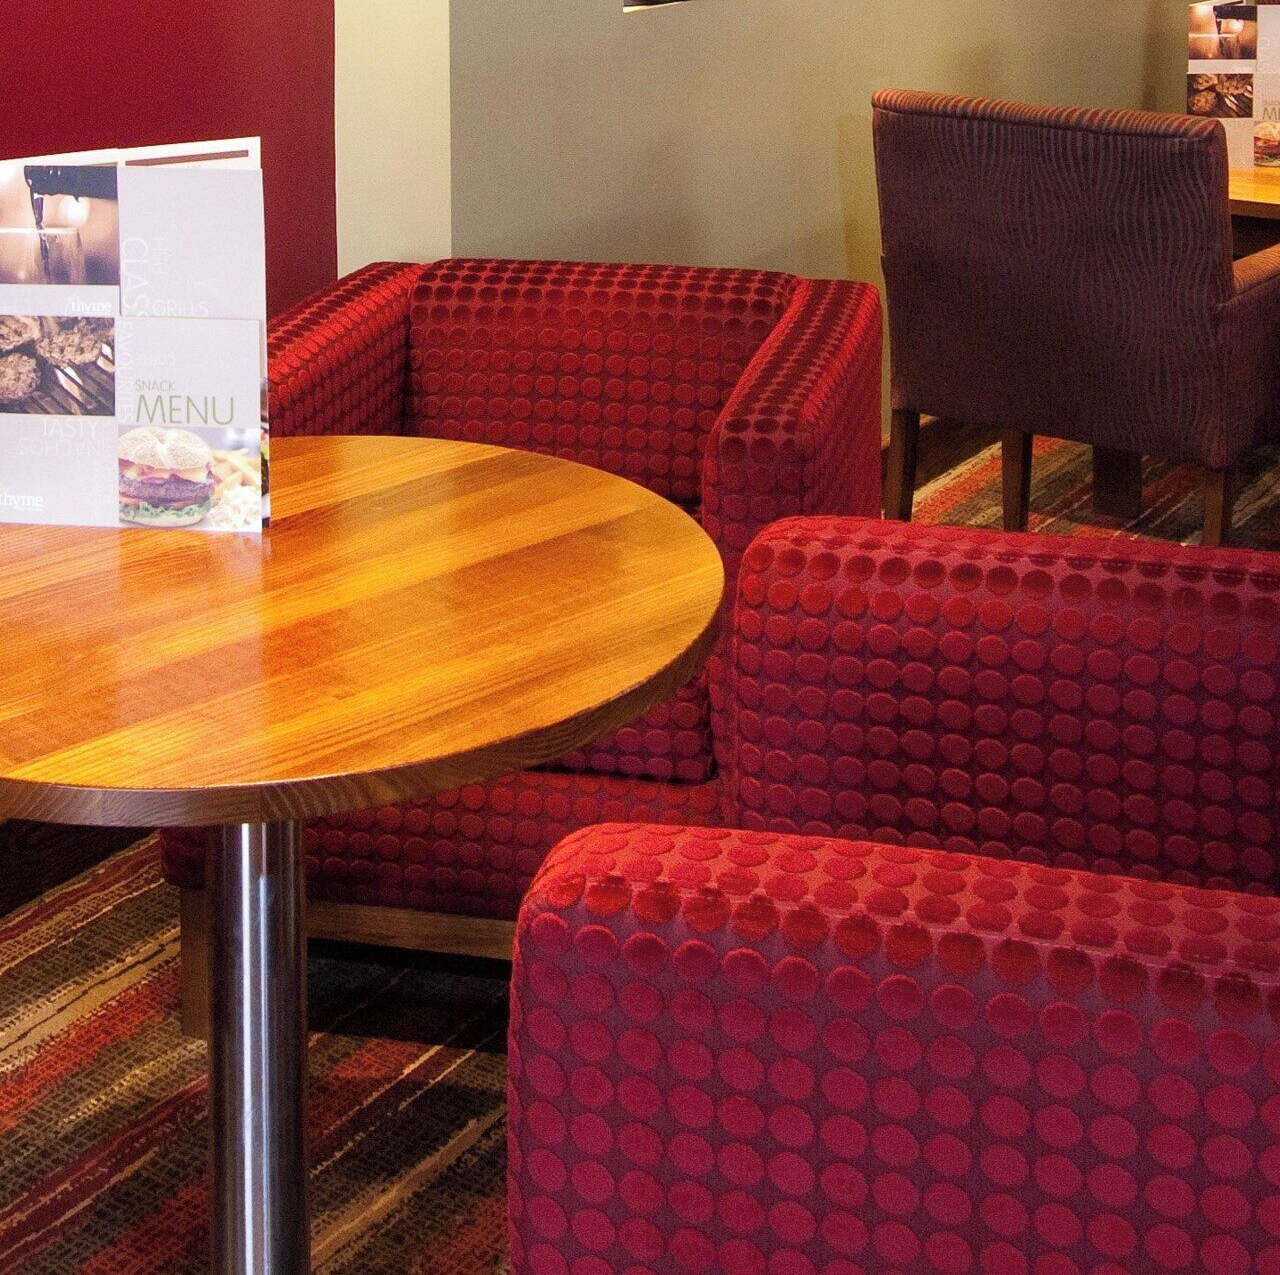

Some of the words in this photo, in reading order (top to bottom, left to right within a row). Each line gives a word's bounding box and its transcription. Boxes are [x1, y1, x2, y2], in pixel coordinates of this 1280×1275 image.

[71, 298, 111, 313] thyme
[152, 299, 209, 317] GRILLS
[116, 321, 134, 423] FAVOURITES
[135, 379, 176, 392] SNACK
[136, 393, 235, 426] MENU
[40, 417, 101, 439] TASTY
